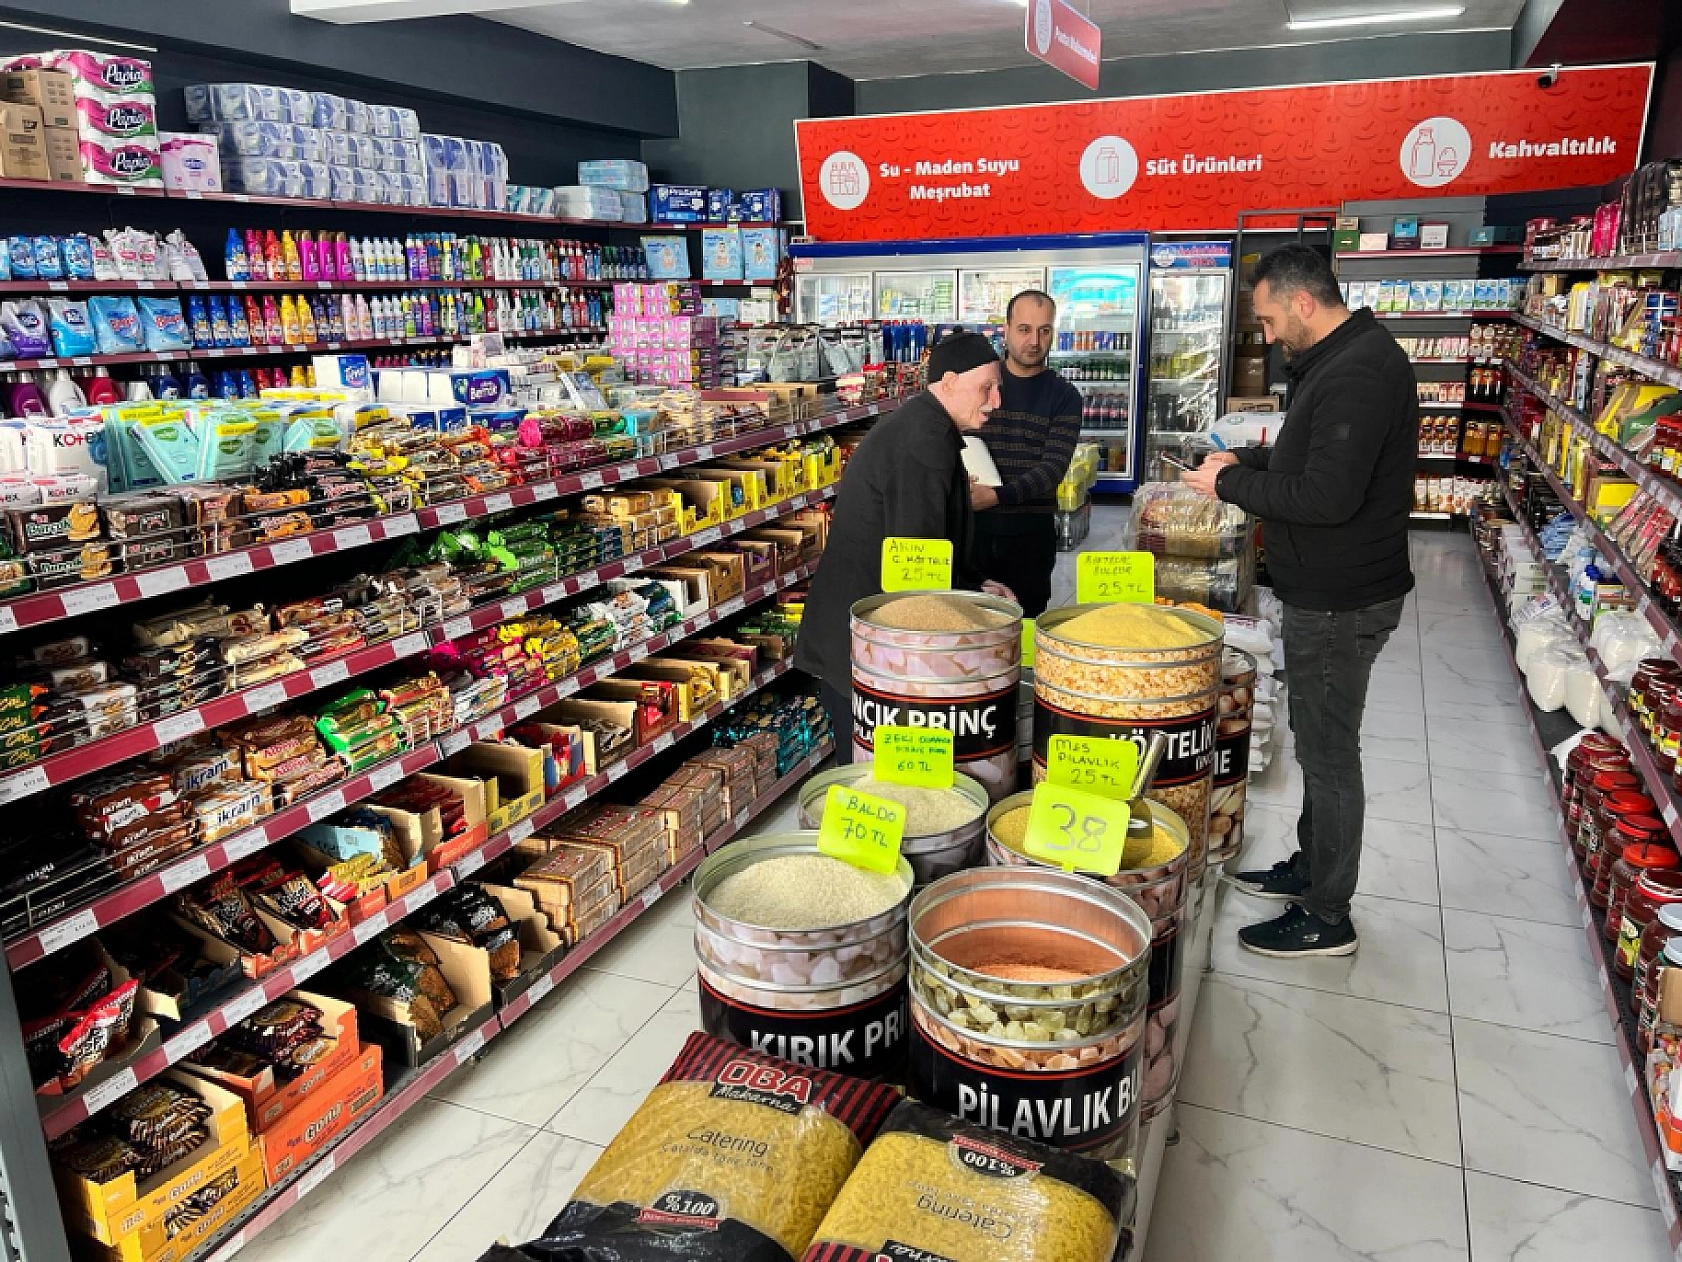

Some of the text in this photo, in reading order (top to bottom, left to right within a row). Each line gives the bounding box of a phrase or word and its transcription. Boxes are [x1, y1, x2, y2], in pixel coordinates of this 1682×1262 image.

[1489, 135, 1617, 160] Kahvaltılık
[879, 163, 900, 178] Su
[915, 160, 973, 176] Maden
[977, 158, 1019, 176] Suyu
[1146, 154, 1263, 176] Süt Ürünleri
[910, 182, 991, 203] Meşrubat
[1098, 581, 1123, 597] 25
[185, 759, 229, 790] ikram
[1071, 768, 1096, 784] 25
[217, 793, 261, 824] ikram
[846, 796, 897, 823] BALDO
[841, 817, 888, 848] 70 TL
[1048, 803, 1108, 855] 38
[751, 1028, 855, 1068] KIRIK
[717, 1060, 813, 1104] OBA
[957, 1081, 1112, 1138] PİLAVLIK
[686, 1124, 769, 1158] Catering
[962, 1150, 1016, 1177] %100
[664, 1194, 716, 1216] %100
[915, 1194, 1013, 1240] Catering
